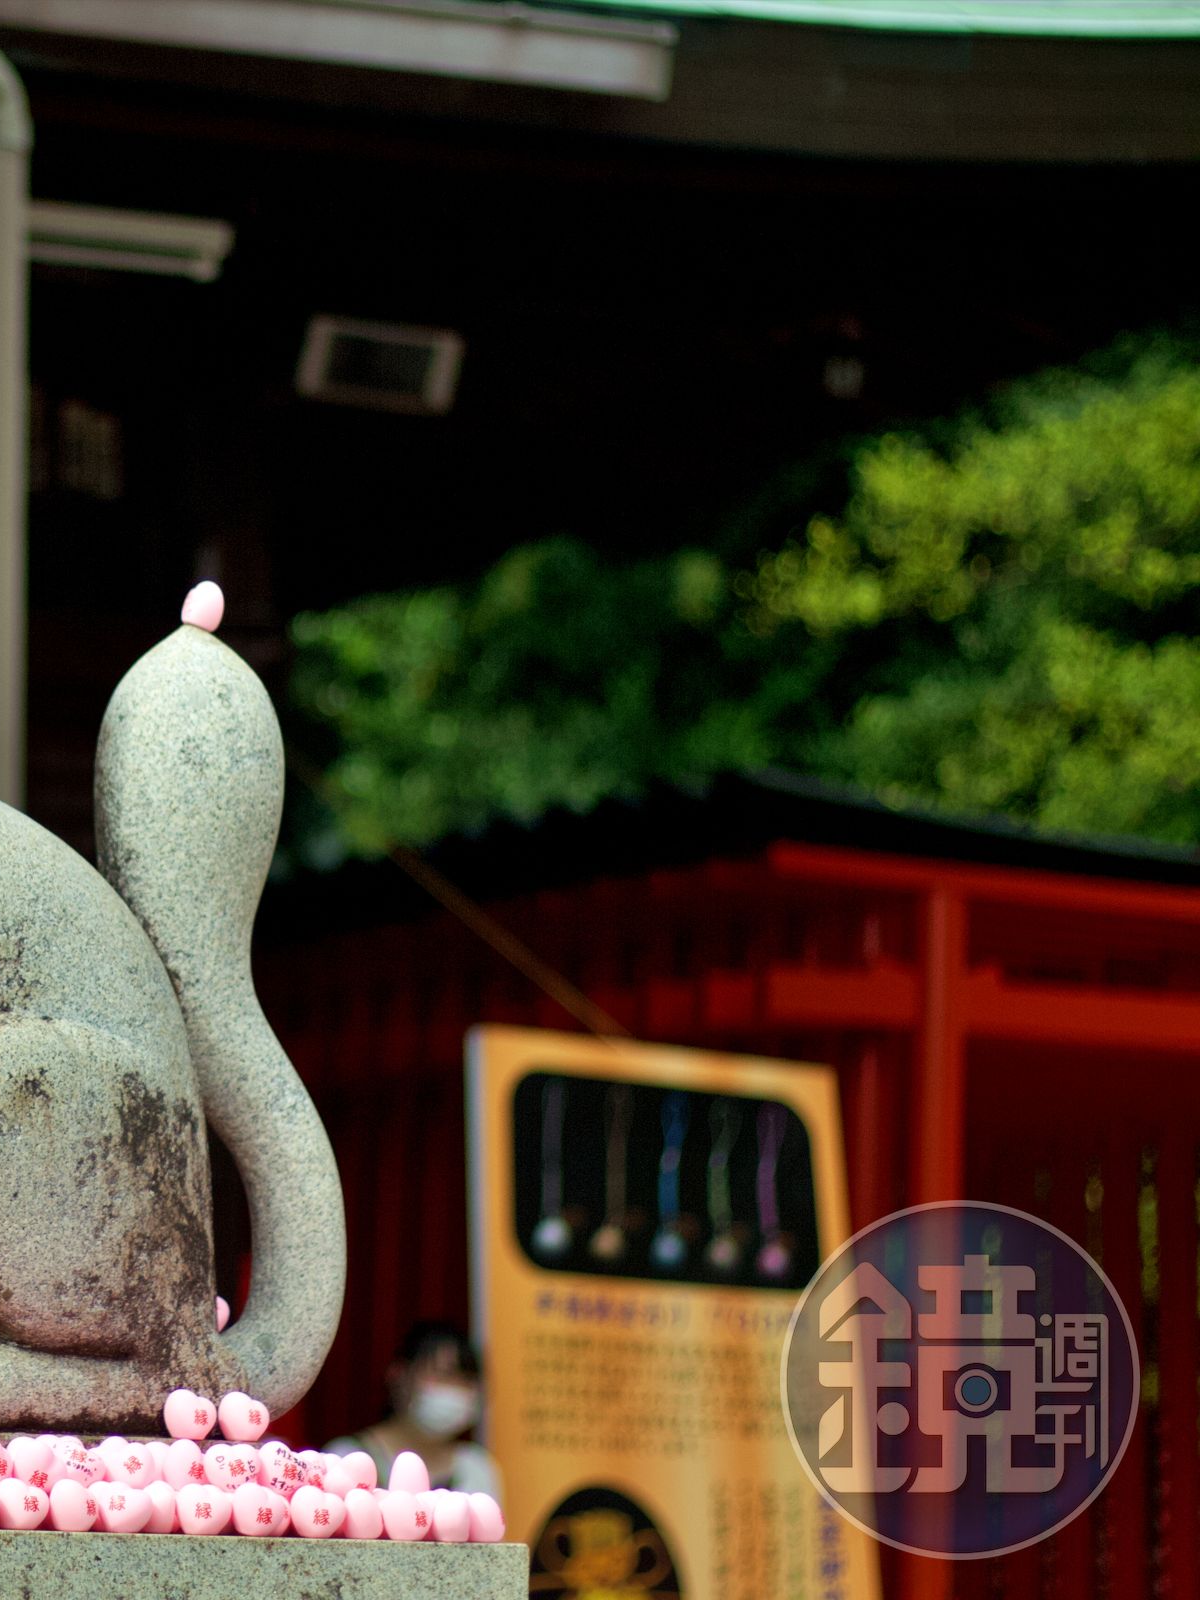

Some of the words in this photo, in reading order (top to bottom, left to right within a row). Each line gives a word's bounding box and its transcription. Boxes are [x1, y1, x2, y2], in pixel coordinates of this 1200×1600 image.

[194, 1409, 208, 1425] 縁
[228, 1459, 248, 1478] 縁
[283, 1462, 298, 1482] 縁
[29, 1470, 48, 1489] 縁
[24, 1496, 39, 1512] 縁
[195, 1503, 212, 1519] 縁
[256, 1507, 272, 1524] 縁
[313, 1509, 329, 1525] 縁
